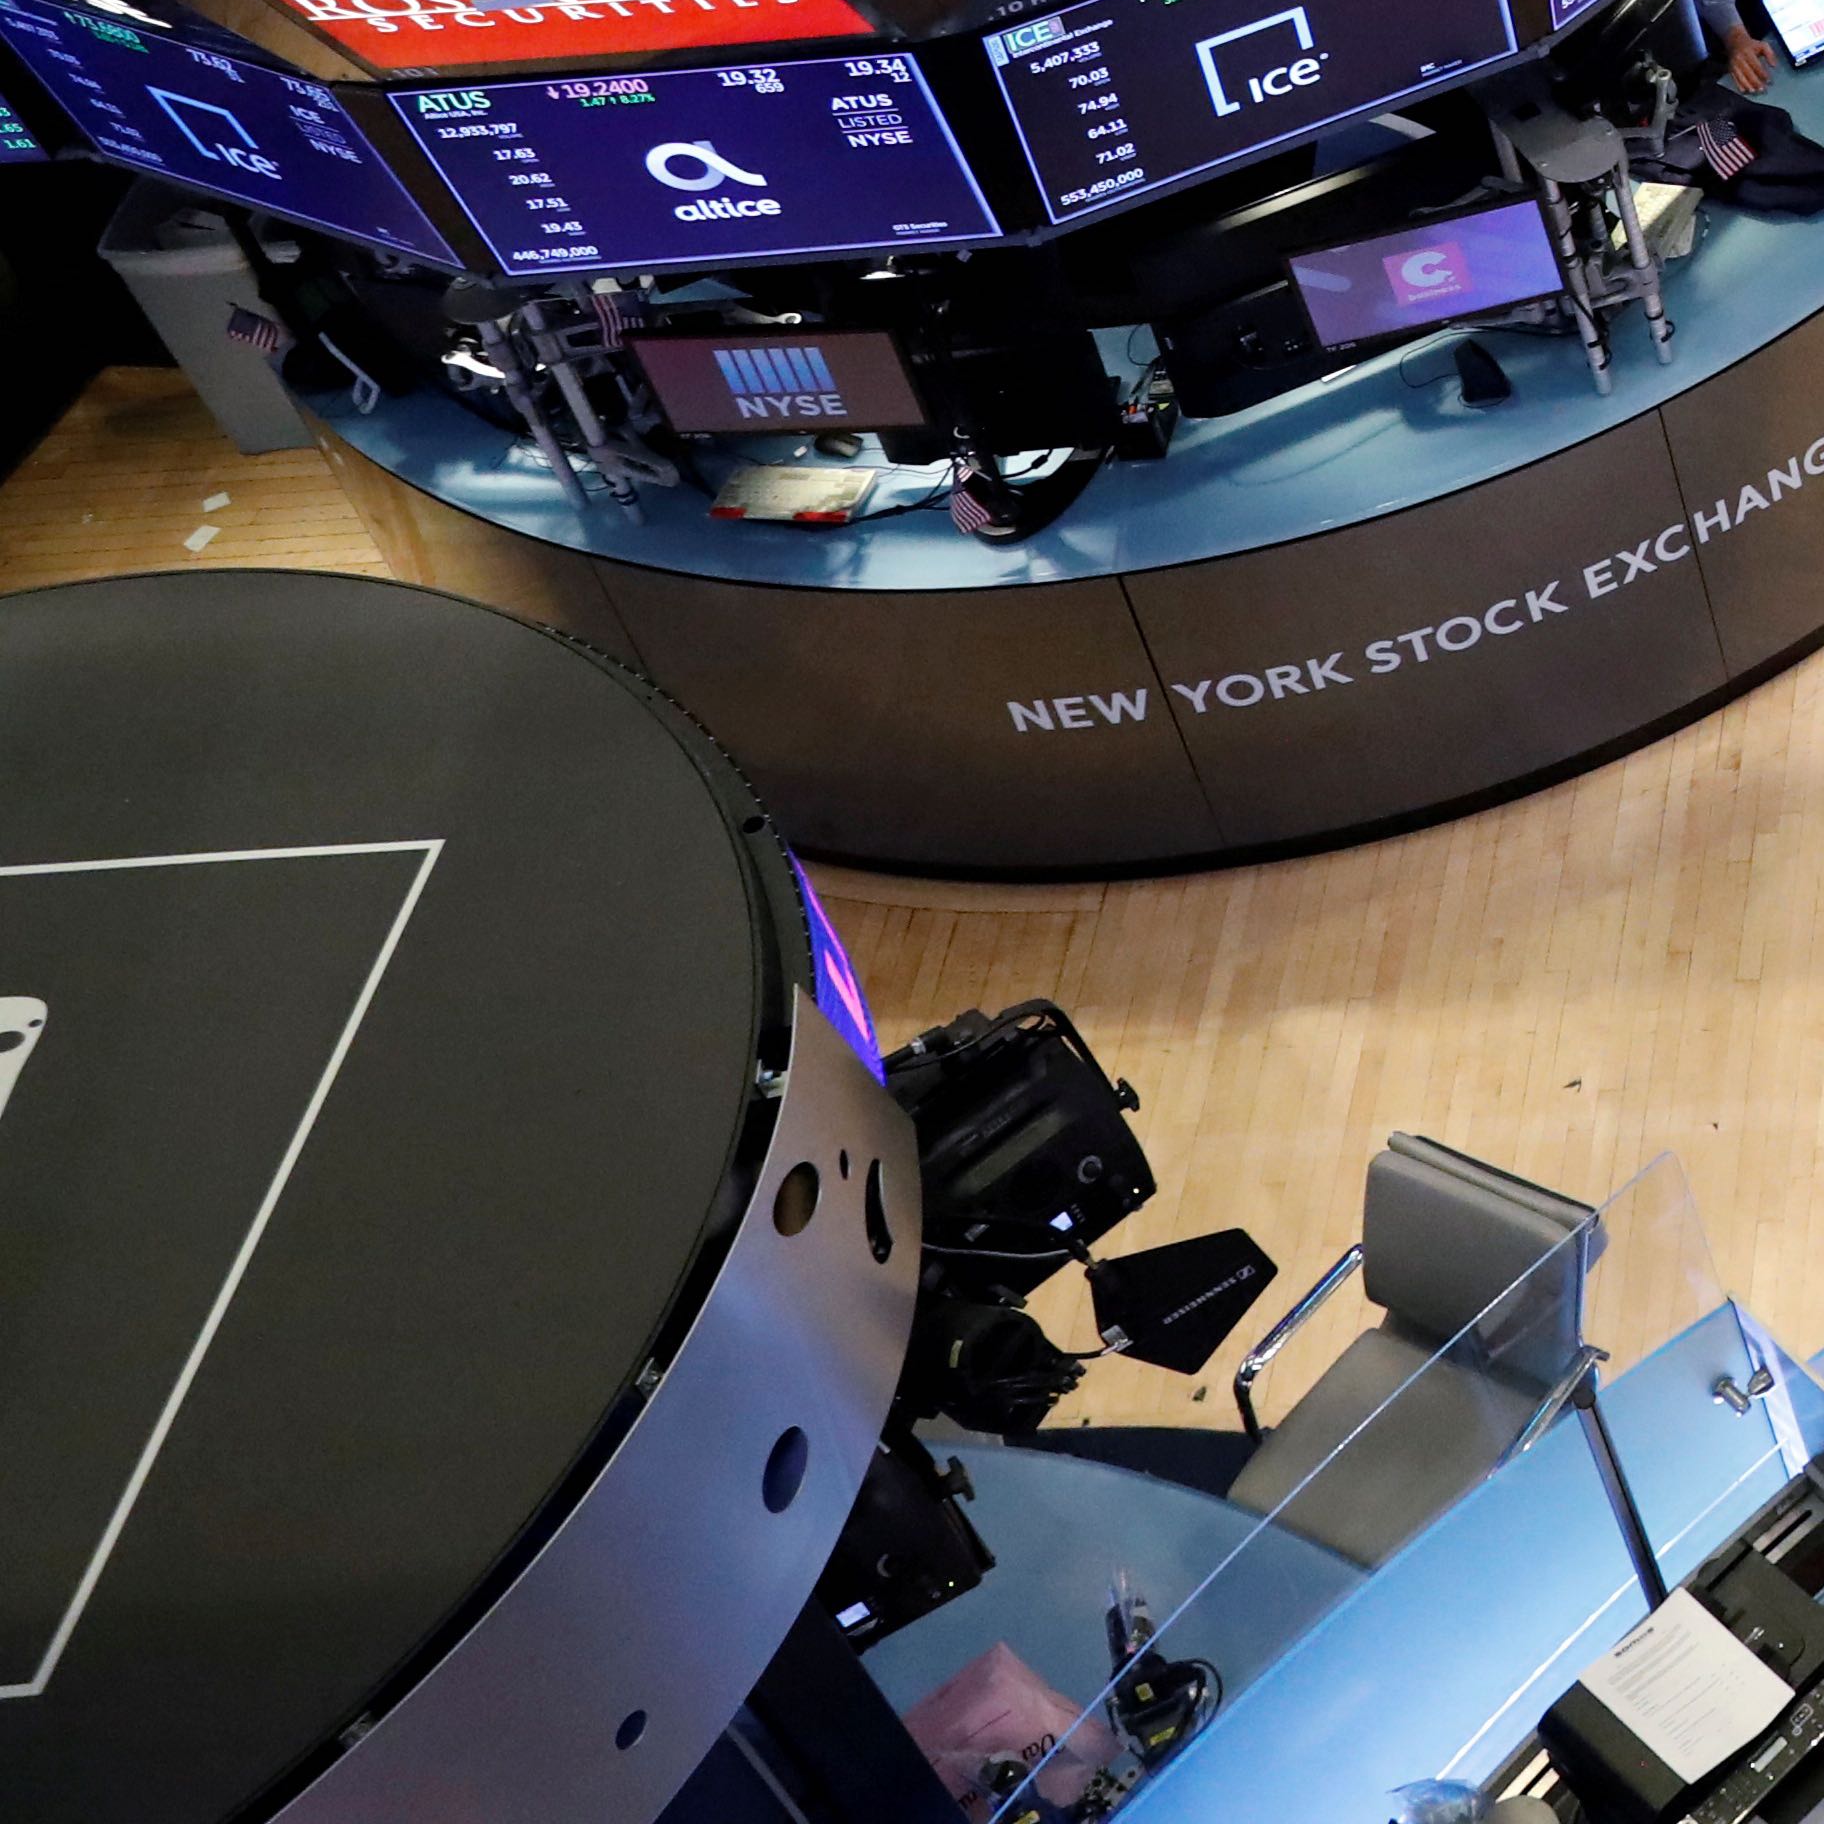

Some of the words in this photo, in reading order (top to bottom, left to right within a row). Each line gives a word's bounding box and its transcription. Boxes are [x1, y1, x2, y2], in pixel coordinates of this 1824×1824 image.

[1007, 20, 1053, 52] ICE
[845, 59, 908, 77] 19.34
[1030, 41, 1101, 74] 5,407,333
[717, 68, 781, 88] 19.32
[1069, 67, 1109, 89] 70.03
[565, 78, 650, 101] 19.2400
[416, 90, 493, 114] ATUS
[830, 93, 894, 111] ATUS
[1077, 92, 1119, 115] 74.94
[437, 122, 519, 140] 12,933,797
[837, 113, 903, 129] LISTED
[1087, 118, 1127, 139] 64.11
[846, 130, 914, 148] NYSE
[492, 146, 537, 161] 17.63
[1095, 142, 1136, 164] 71.02
[508, 172, 553, 187] 20.62
[1060, 167, 1144, 206] 553,450,000
[525, 196, 569, 211] 17.51
[673, 196, 783, 223] altice
[540, 220, 584, 235] 19.43
[512, 244, 600, 262] 446,749,000
[735, 393, 849, 420] NYSE
[1005, 688, 1150, 734] NEW
[1171, 651, 1355, 715] YORK
[1364, 579, 1572, 675] STOCK
[1161, 1276, 1239, 1326] SENNHEISER
